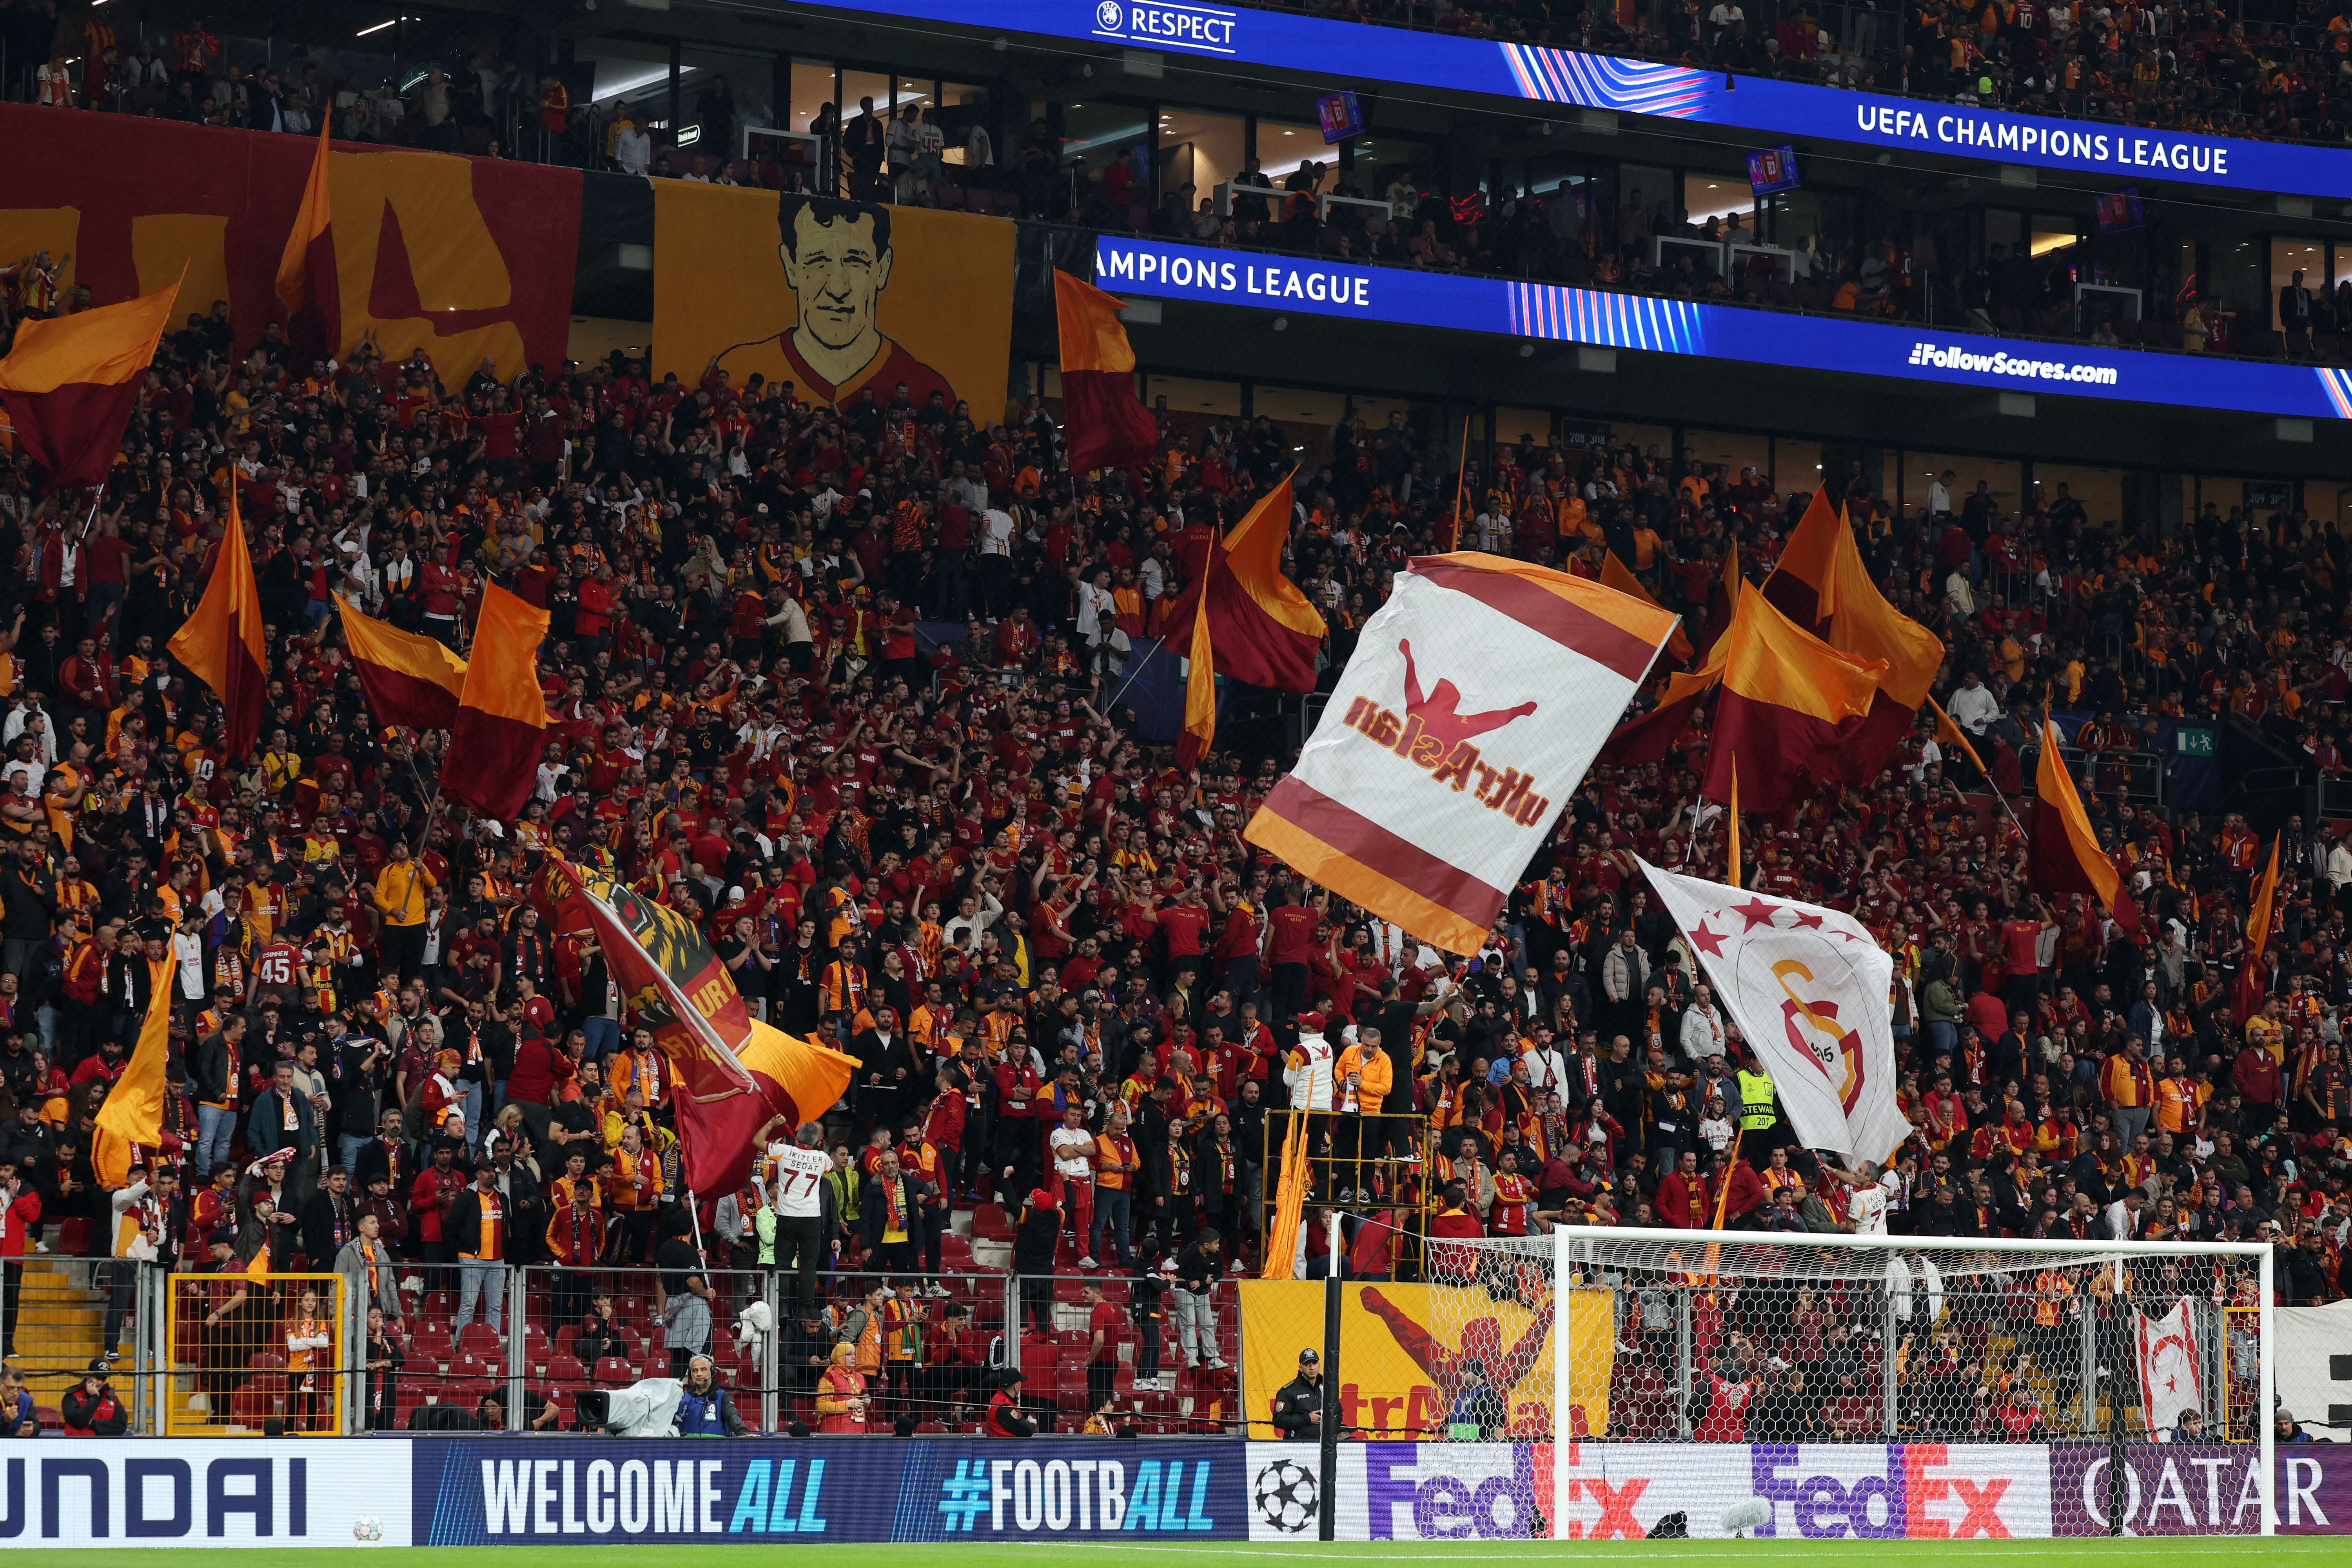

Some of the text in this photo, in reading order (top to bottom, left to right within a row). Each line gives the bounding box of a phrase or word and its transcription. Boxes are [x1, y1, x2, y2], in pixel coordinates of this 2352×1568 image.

[1132, 8, 1236, 44] RESPECT
[2019, 13, 2033, 29] 10
[1336, 108, 1343, 122] 83
[922, 138, 940, 155] 45
[1858, 105, 2227, 174] UEFA CHAMPIONS LEAGUE
[1768, 161, 1776, 175] 83
[1247, 266, 1369, 306] LEAGUE
[1921, 344, 2117, 385] FollowScores.com
[1570, 433, 1606, 444] 208 308
[2250, 493, 2265, 503] 209
[862, 753, 875, 763] UNI
[194, 758, 215, 781] 10
[1668, 864, 1683, 873] UNI
[262, 950, 289, 959] OSIMHEN
[260, 958, 290, 984] 45
[1436, 1100, 1452, 1109] SIXT
[1743, 1104, 1775, 1115] STEWARD
[1757, 1117, 1769, 1126] 207
[791, 1160, 818, 1172] SEDAT
[783, 1168, 818, 1198] 77
[1872, 1198, 1886, 1210] VEDA
[481, 1459, 827, 1534] WELCOME ALL
[938, 1459, 1214, 1532] #FOOTBALL
[1366, 1443, 1649, 1540] FedEx
[1751, 1443, 2012, 1539] FedEx
[2083, 1457, 2330, 1537] QATAR
